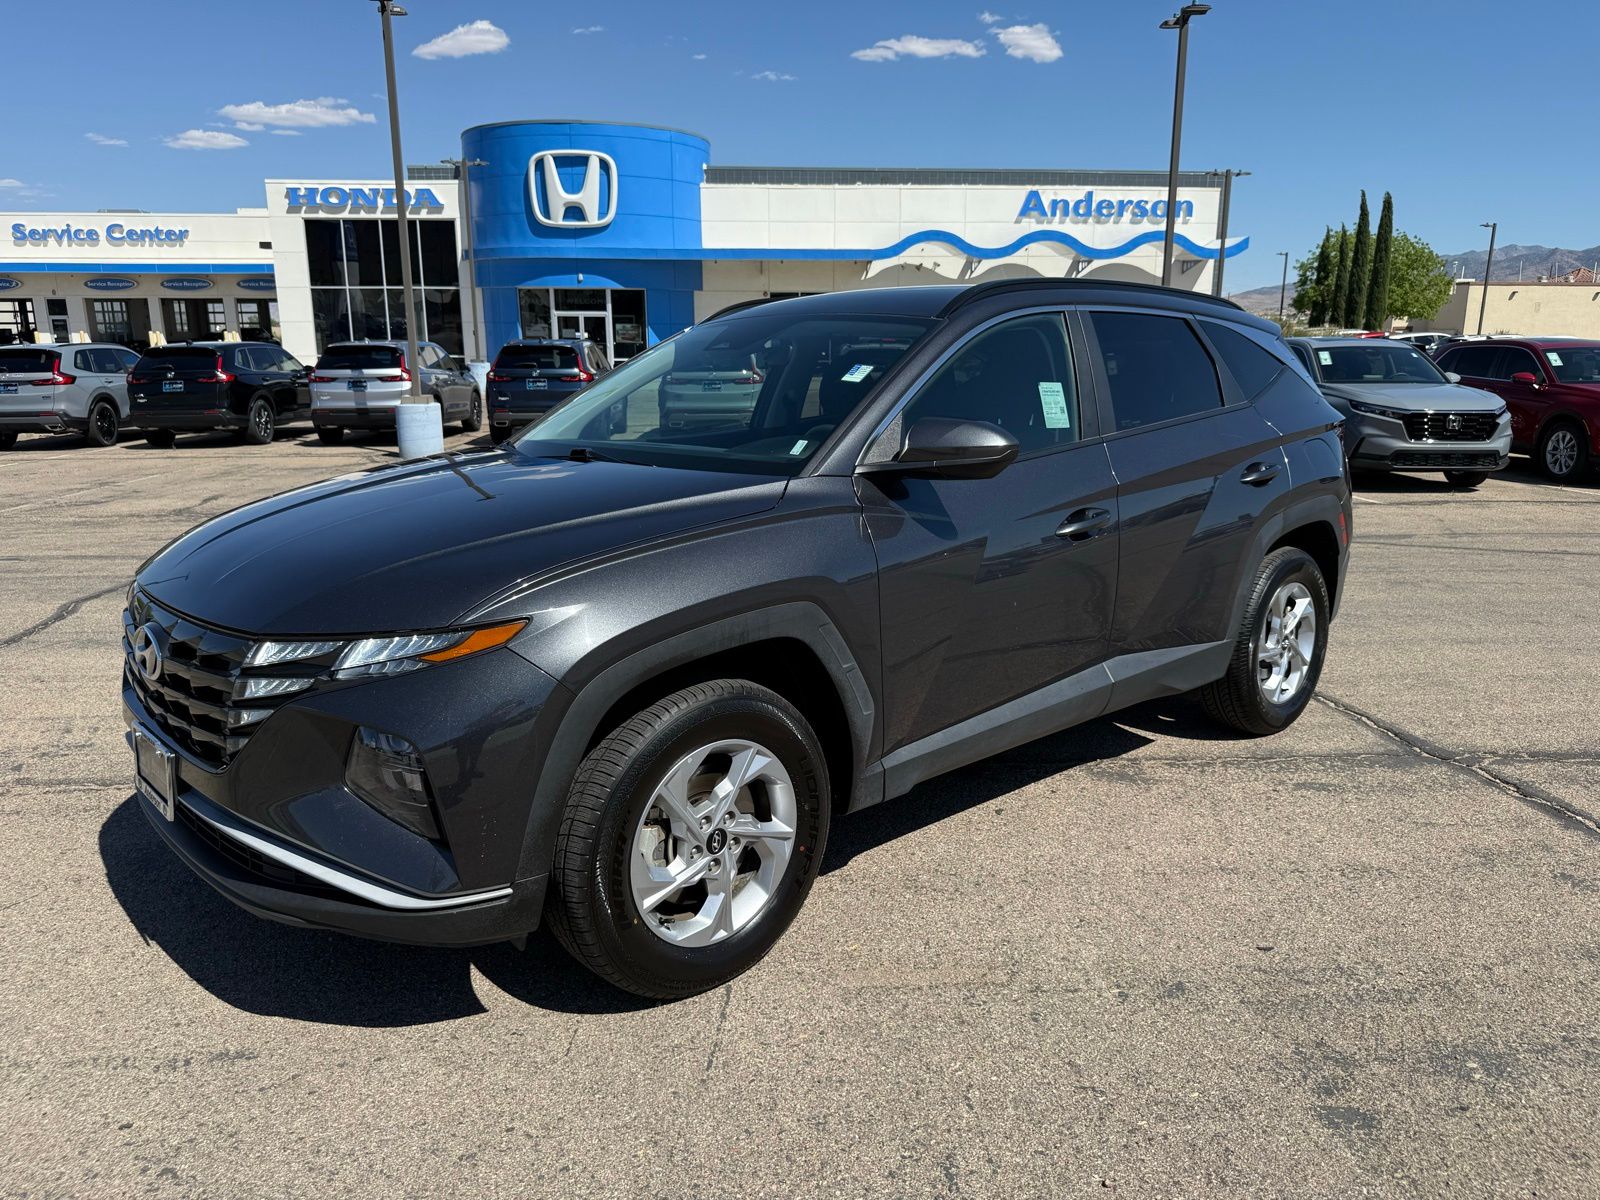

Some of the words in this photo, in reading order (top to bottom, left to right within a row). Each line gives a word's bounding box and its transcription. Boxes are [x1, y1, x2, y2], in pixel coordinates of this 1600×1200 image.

[285, 186, 445, 208] HONDA
[1017, 189, 1194, 219] Anderson
[11, 223, 100, 241] Service
[105, 223, 190, 242] Center
